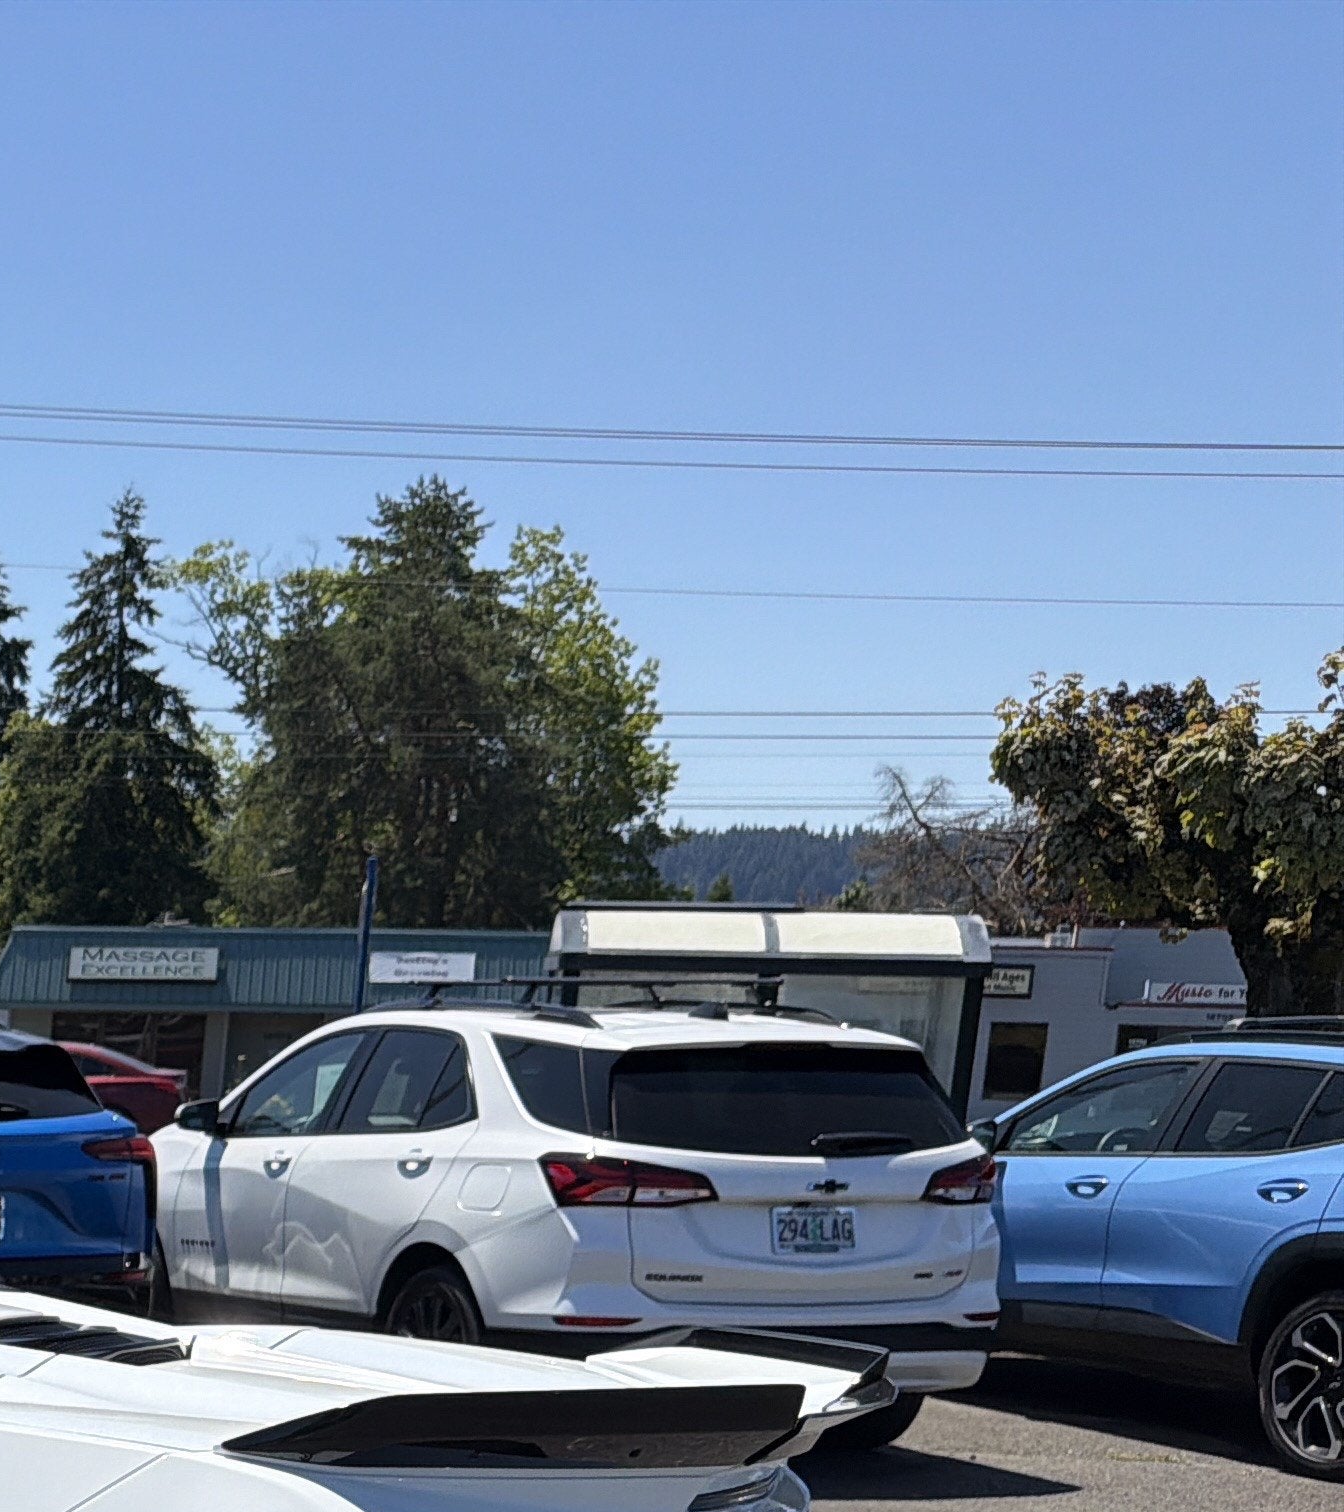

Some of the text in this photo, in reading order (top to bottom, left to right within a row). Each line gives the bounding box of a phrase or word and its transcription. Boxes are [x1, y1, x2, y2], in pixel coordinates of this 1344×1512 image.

[81, 949, 205, 963] MASSAGE
[80, 964, 205, 977] EXCELLENCE
[1156, 982, 1212, 1003] Music
[1218, 987, 1234, 998] for
[776, 1217, 854, 1243] 294 LAG
